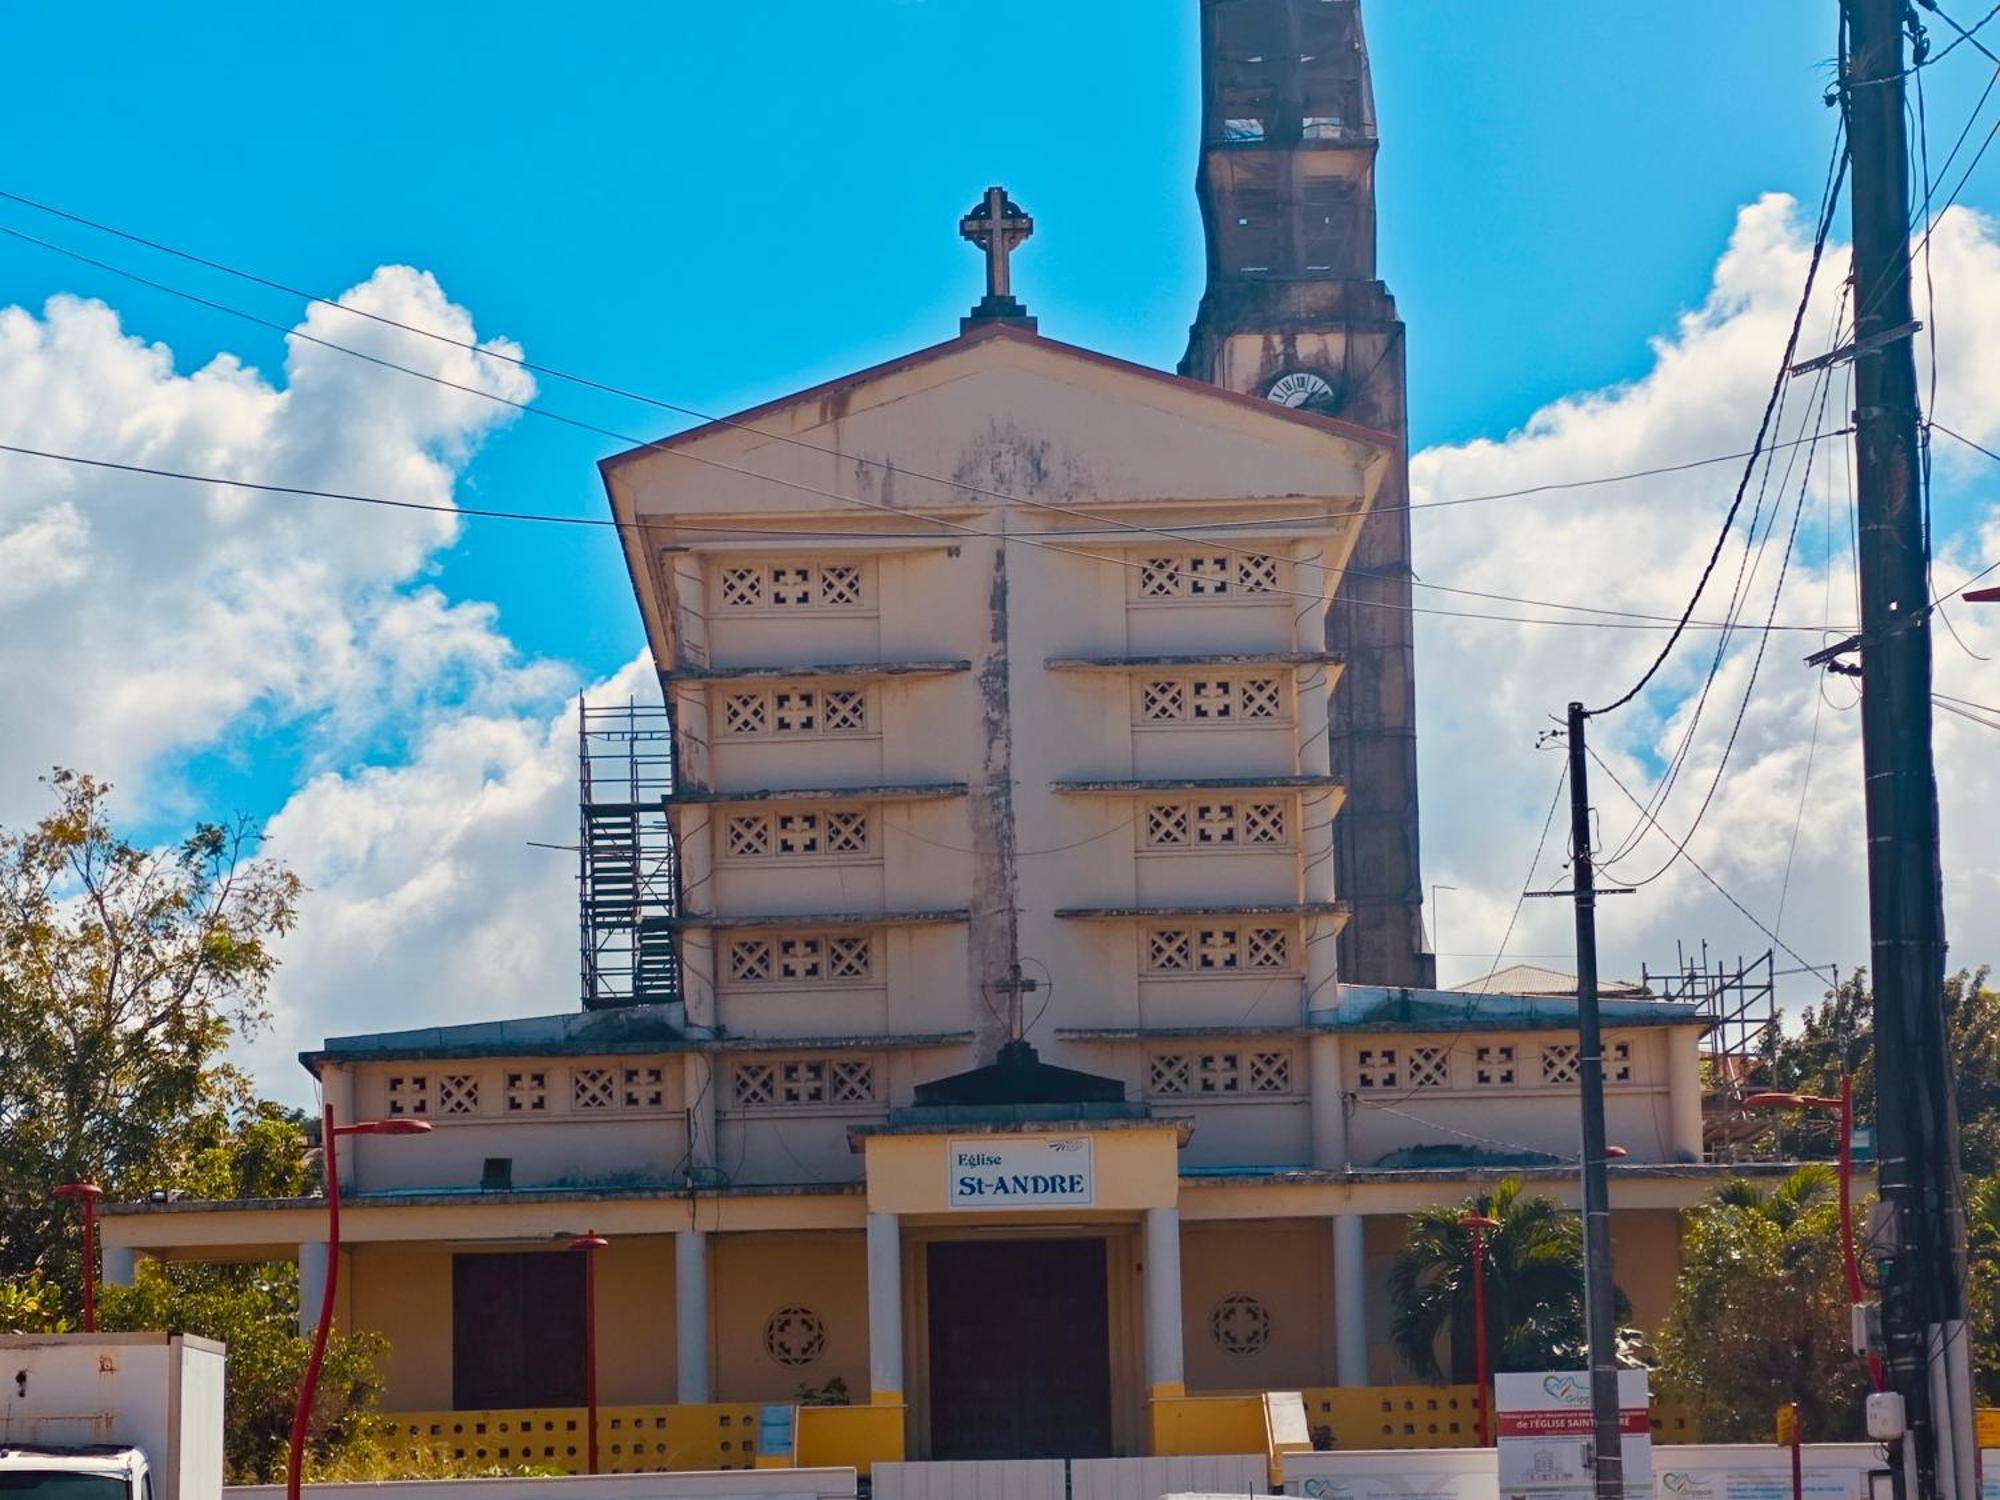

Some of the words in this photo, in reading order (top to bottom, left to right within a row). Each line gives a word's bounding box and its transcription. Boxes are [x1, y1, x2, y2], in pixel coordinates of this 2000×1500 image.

[958, 1154, 1002, 1168] Eglise
[959, 1174, 1084, 1196] St-ANDRE
[1516, 1419, 1529, 1430] de
